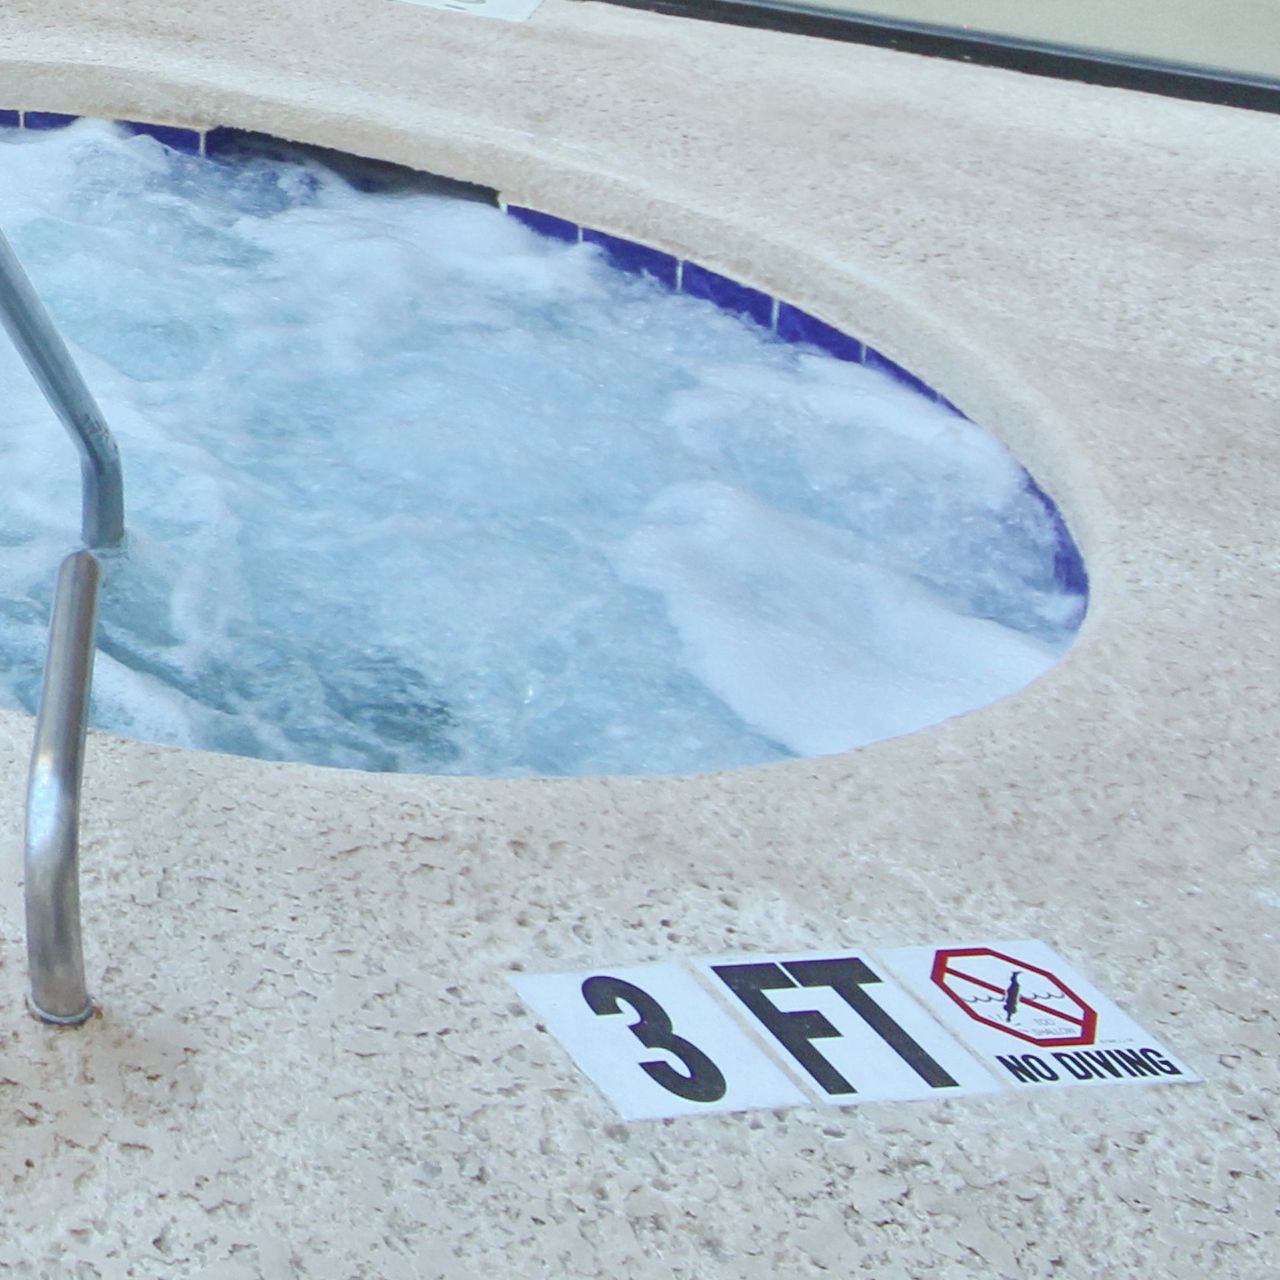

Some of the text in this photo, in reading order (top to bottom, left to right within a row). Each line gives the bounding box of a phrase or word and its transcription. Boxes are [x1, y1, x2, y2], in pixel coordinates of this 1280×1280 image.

[581, 956, 961, 1103] 3 FT
[995, 1047, 1183, 1083] NO DIVING
